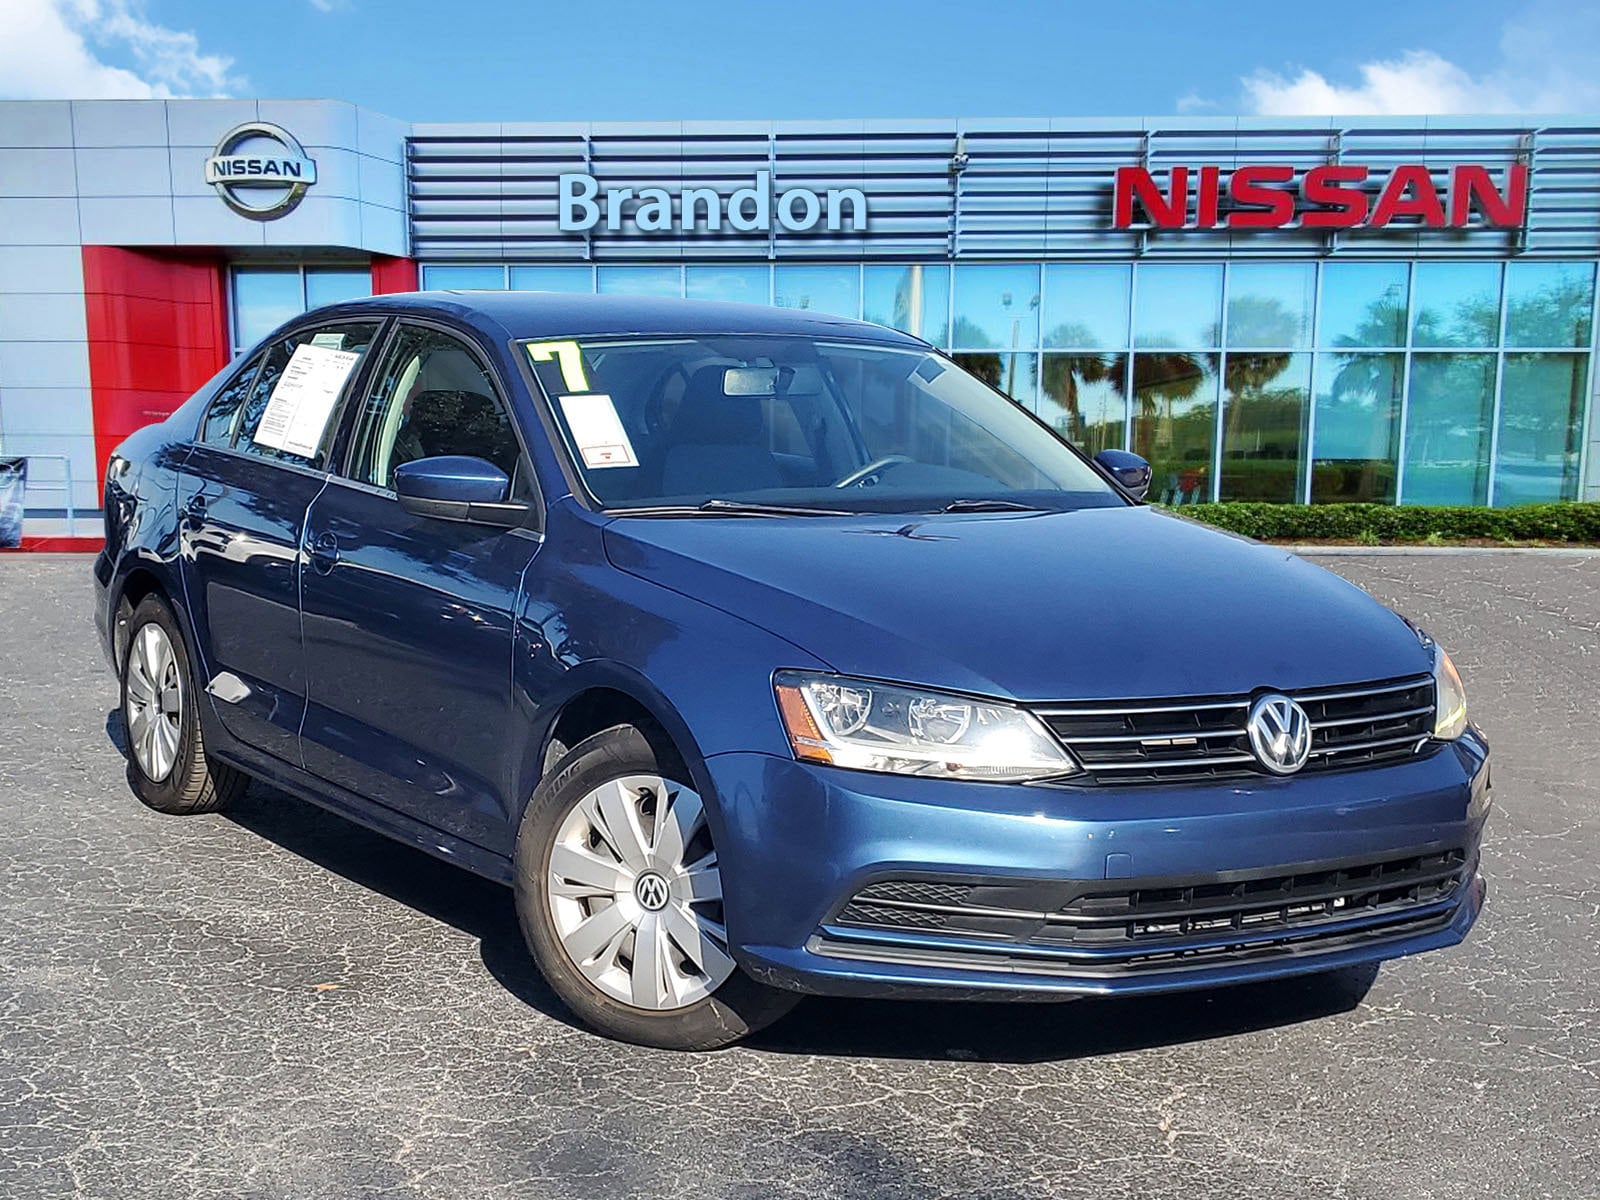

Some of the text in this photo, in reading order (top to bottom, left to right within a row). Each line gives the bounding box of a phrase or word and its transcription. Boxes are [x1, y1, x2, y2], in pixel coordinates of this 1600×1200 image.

[213, 159, 301, 177] NISSAN
[1113, 164, 1530, 229] NISSAN
[558, 170, 868, 232] Brandon
